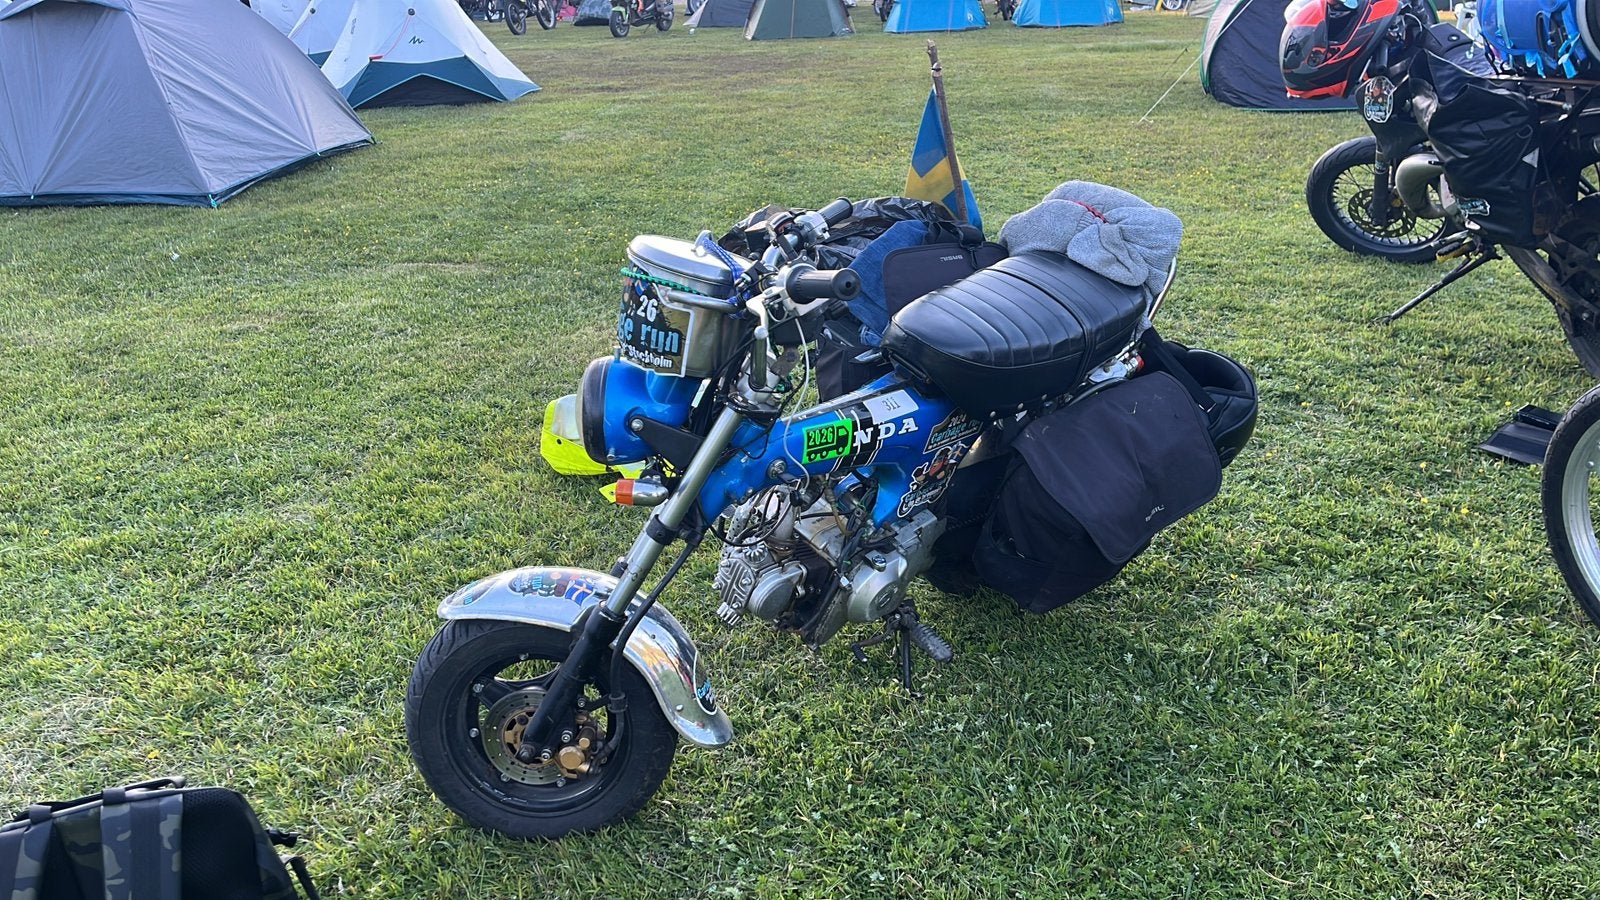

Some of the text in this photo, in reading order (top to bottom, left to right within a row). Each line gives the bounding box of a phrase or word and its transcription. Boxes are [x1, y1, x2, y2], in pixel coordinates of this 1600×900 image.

[640, 323, 679, 353] run
[808, 427, 833, 446] 2026
[853, 417, 919, 447] NDA
